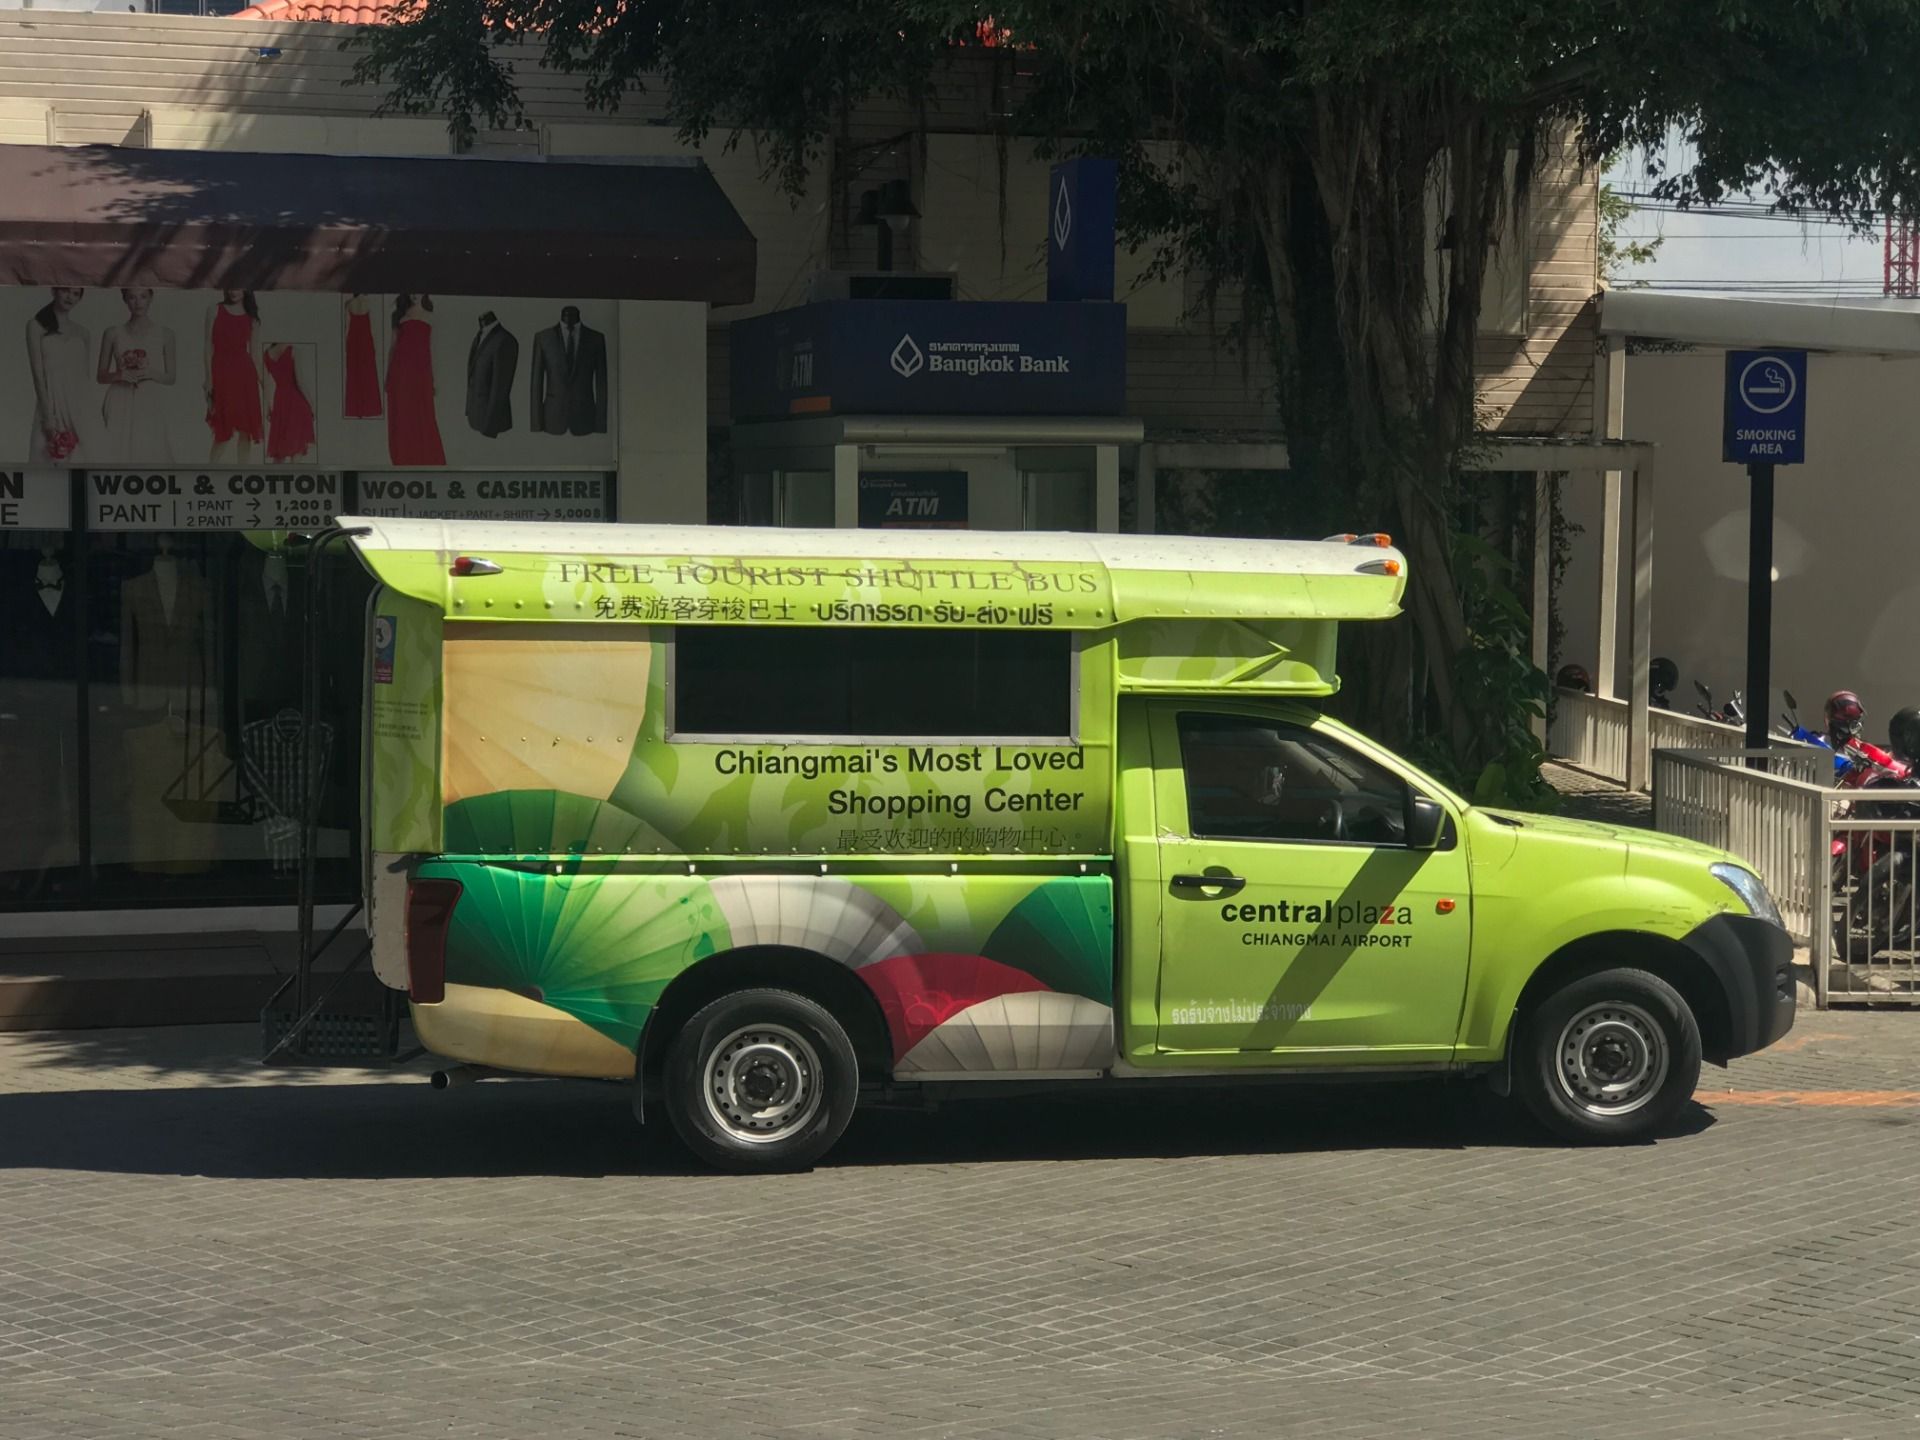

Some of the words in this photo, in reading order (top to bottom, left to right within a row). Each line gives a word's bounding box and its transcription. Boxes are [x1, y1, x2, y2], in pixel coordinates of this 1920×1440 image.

[929, 342, 1020, 355] ธนาคารกรุงเทพ
[929, 355, 1014, 376] Bangkok
[1020, 356, 1070, 373] Bank
[1736, 429, 1796, 441] SMOKING
[1750, 443, 1783, 454] AREA
[93, 475, 181, 495] WOOL
[193, 475, 215, 495] &
[228, 475, 336, 495] COTTON
[362, 481, 437, 499] WOOL
[447, 481, 466, 499] &
[477, 480, 601, 499] CASHMERE
[99, 504, 162, 523] PANT
[187, 501, 193, 511] 1
[198, 500, 233, 511] PANT
[275, 499, 320, 512] 1,200
[466, 510, 494, 519] PANT
[503, 510, 535, 519] SHIRT
[886, 497, 939, 516] ATM
[186, 516, 196, 527] 2
[198, 516, 234, 527] PANT
[275, 515, 320, 528] 2,000
[560, 562, 654, 585] FREE
[673, 563, 829, 587] TOURIST
[844, 567, 1013, 592] SHUTTLE
[1027, 571, 1097, 593] BUS
[594, 595, 796, 623] 免费游客穿梭巴士
[816, 598, 925, 624] บริการรถ
[933, 600, 1008, 625] รับ-ส่ง
[1019, 601, 1054, 626] ฟรี
[714, 749, 898, 779] Chiangmai's
[908, 747, 982, 773] Most
[995, 746, 1084, 772] Loved
[827, 789, 972, 819] Shopping
[984, 787, 1084, 813] Center
[1221, 900, 1412, 929] centralplaza
[1242, 933, 1336, 946] CHIANGMAI
[1341, 934, 1412, 947] AIRPORT
